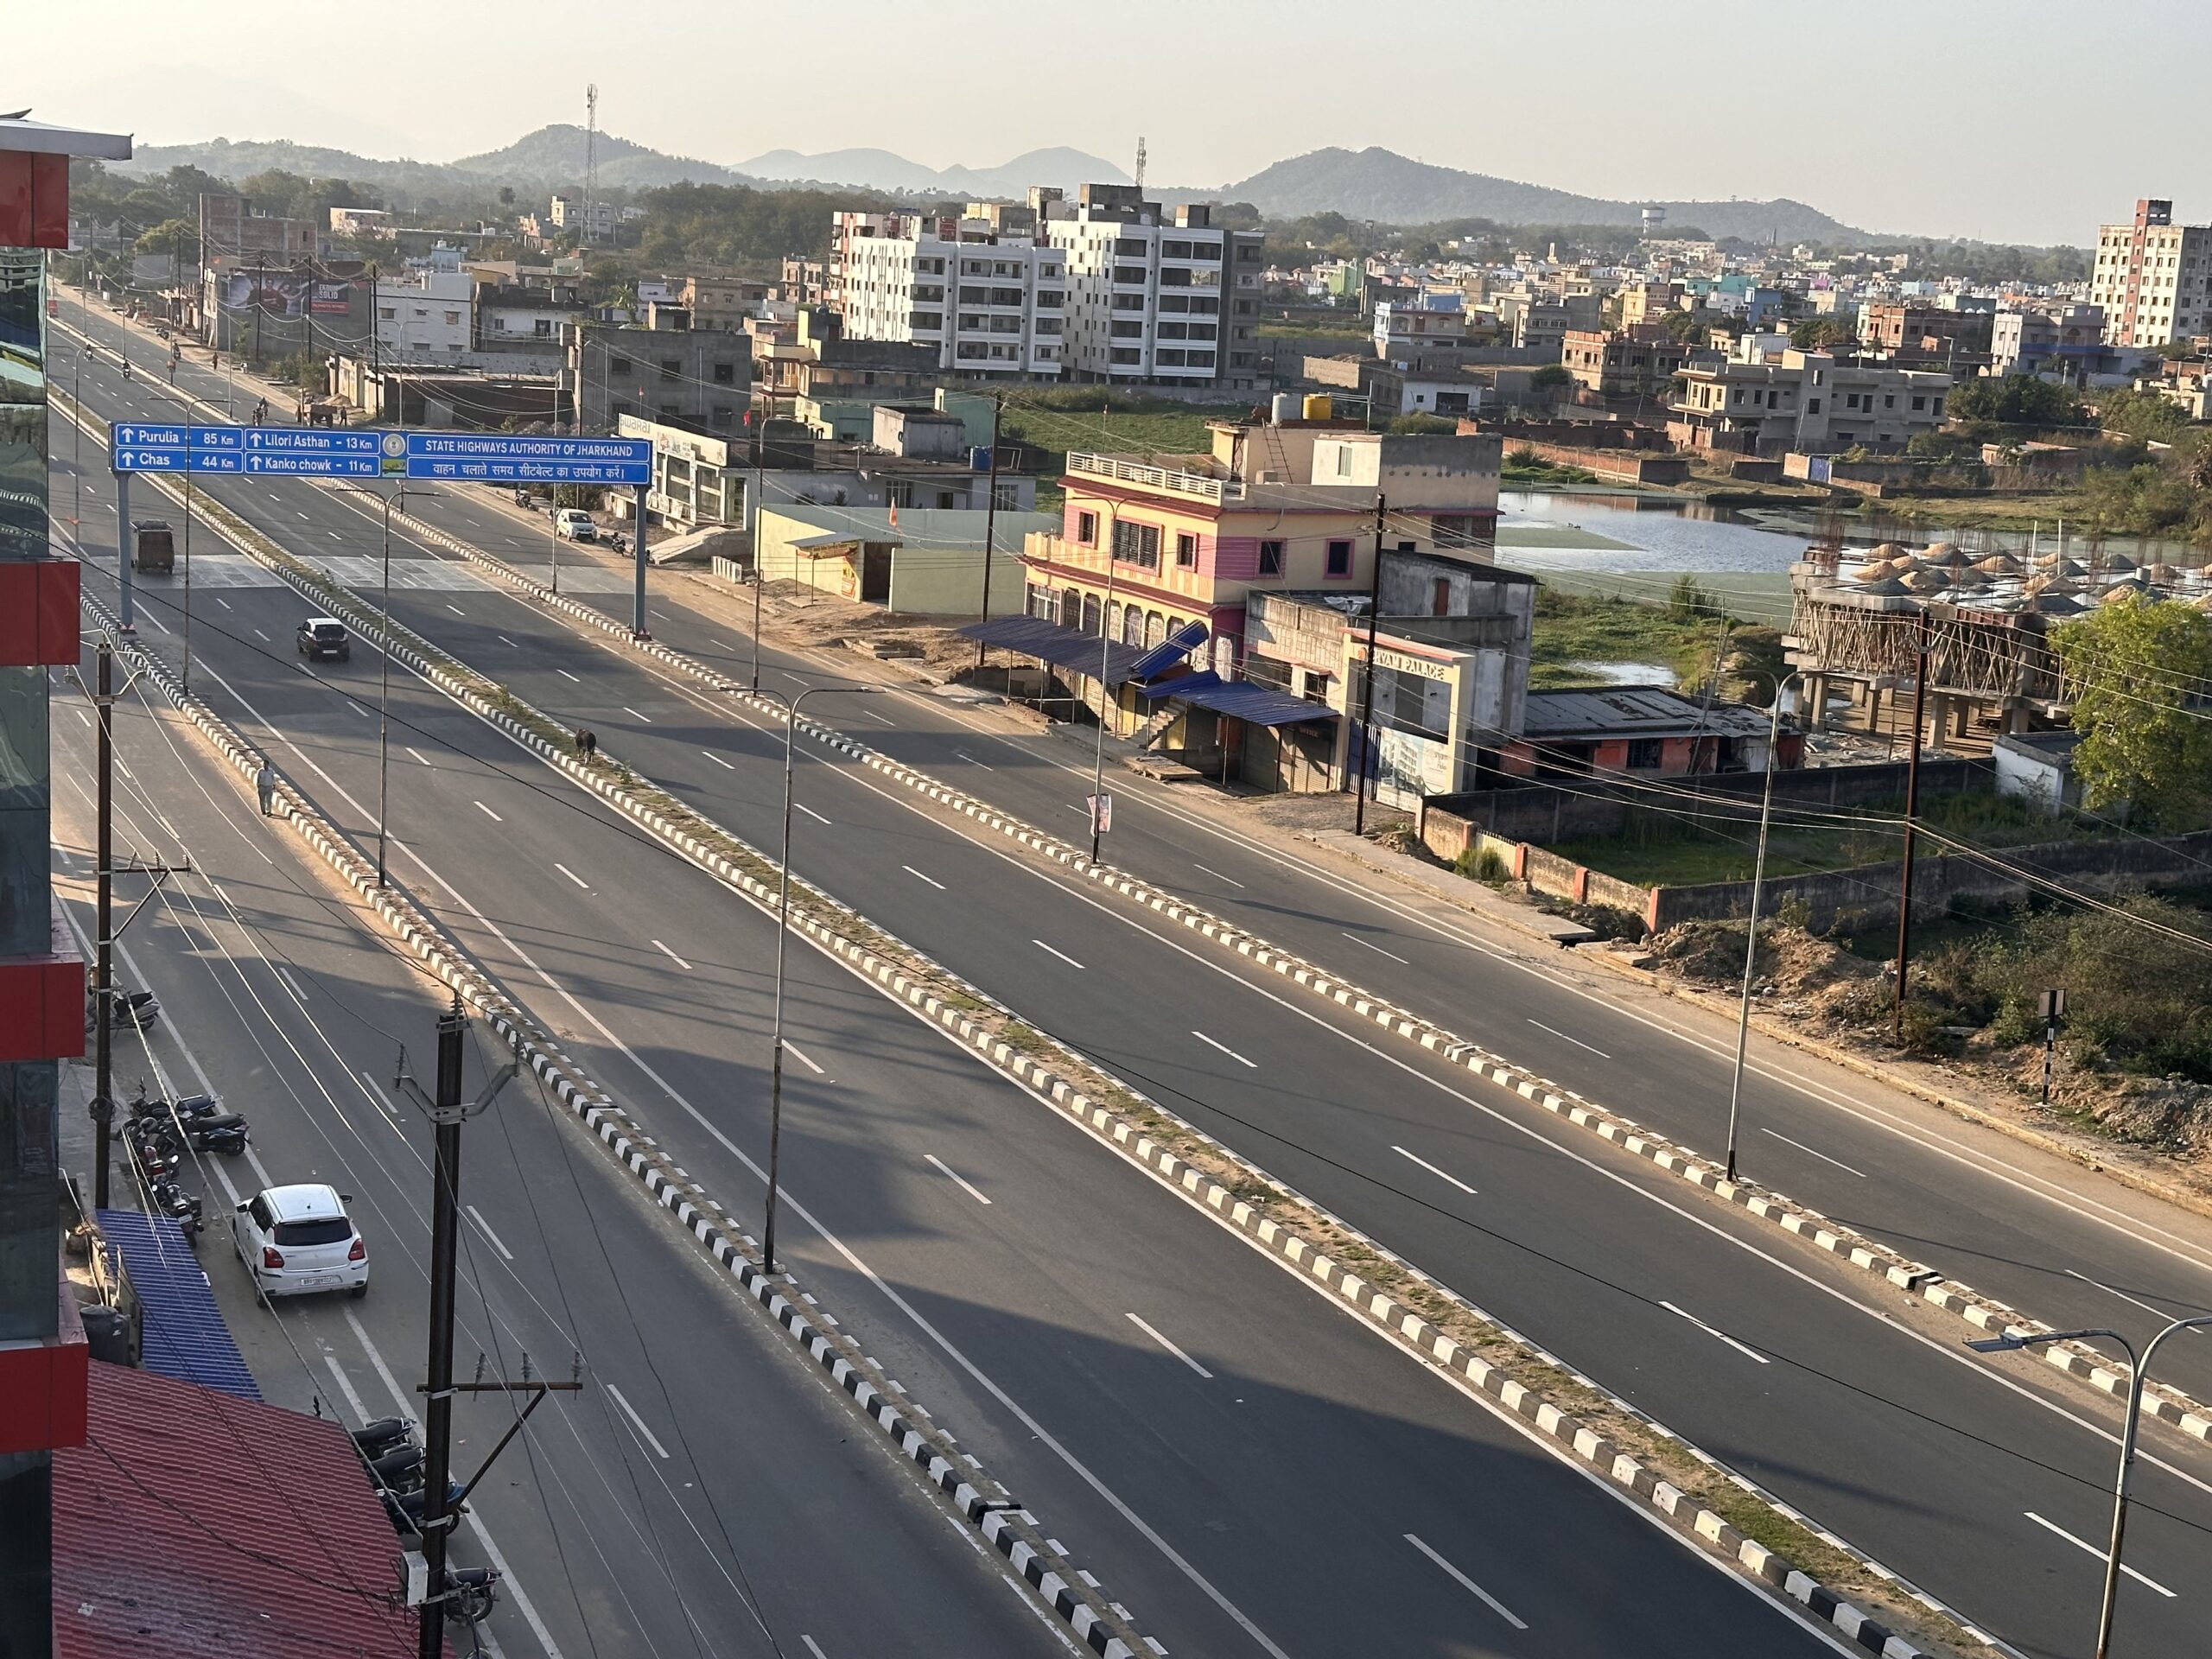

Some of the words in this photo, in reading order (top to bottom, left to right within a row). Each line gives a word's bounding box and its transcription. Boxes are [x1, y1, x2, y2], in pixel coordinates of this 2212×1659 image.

[319, 290, 338, 300] SOLID
[139, 430, 179, 443] Purulia
[203, 433, 217, 444] 85
[221, 435, 233, 445] Km
[265, 435, 291, 447] Lilori
[294, 435, 330, 448] Asthan
[346, 438, 357, 448] 13
[359, 440, 372, 449] Km
[426, 440, 454, 451] STATE
[457, 441, 507, 454] HIGHWAYS
[509, 442, 562, 455] AUTHORITY
[563, 444, 575, 455] OF
[577, 444, 632, 457] JHARKHAND
[140, 453, 170, 465] Chas
[202, 455, 217, 467] 44
[222, 459, 233, 468] Km
[265, 457, 296, 470] Kanko
[299, 458, 331, 471] chowk
[349, 461, 357, 471] 11
[360, 463, 372, 472] Km
[433, 464, 454, 474] वाहन
[461, 461, 487, 474] चलाते
[492, 465, 513, 476] समय
[518, 463, 554, 477] सीटबेल्ट
[556, 467, 568, 477] का
[572, 465, 601, 478] उपयोग
[1405, 658, 1445, 680] PALACE
